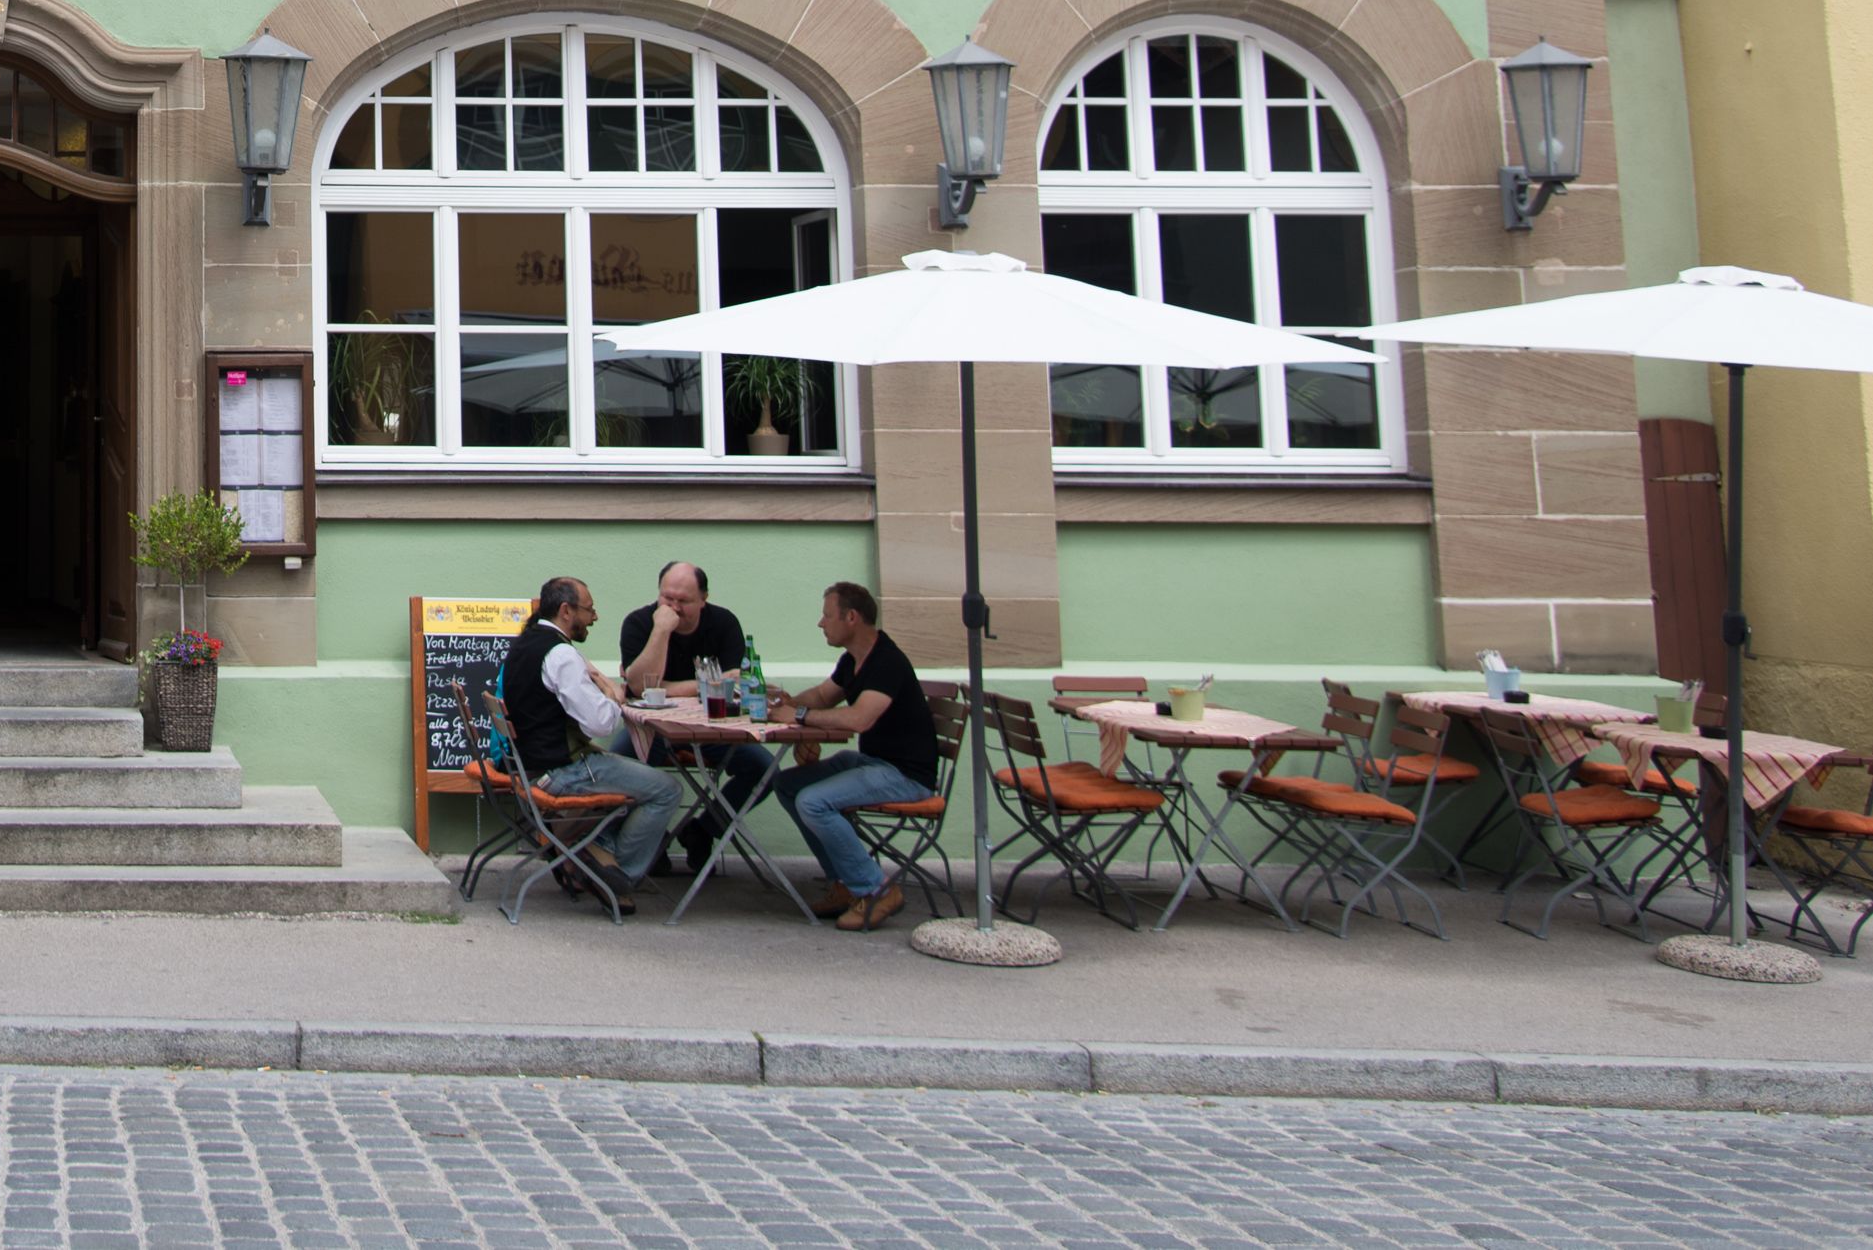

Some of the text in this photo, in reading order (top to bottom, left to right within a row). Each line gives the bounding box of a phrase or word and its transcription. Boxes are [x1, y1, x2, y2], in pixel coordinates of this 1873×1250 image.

[476, 605, 500, 615] Ludwig
[425, 635, 511, 655] Von Montag bis
[426, 651, 463, 667] Freitag
[465, 651, 482, 663] bis
[429, 718, 449, 730] alle
